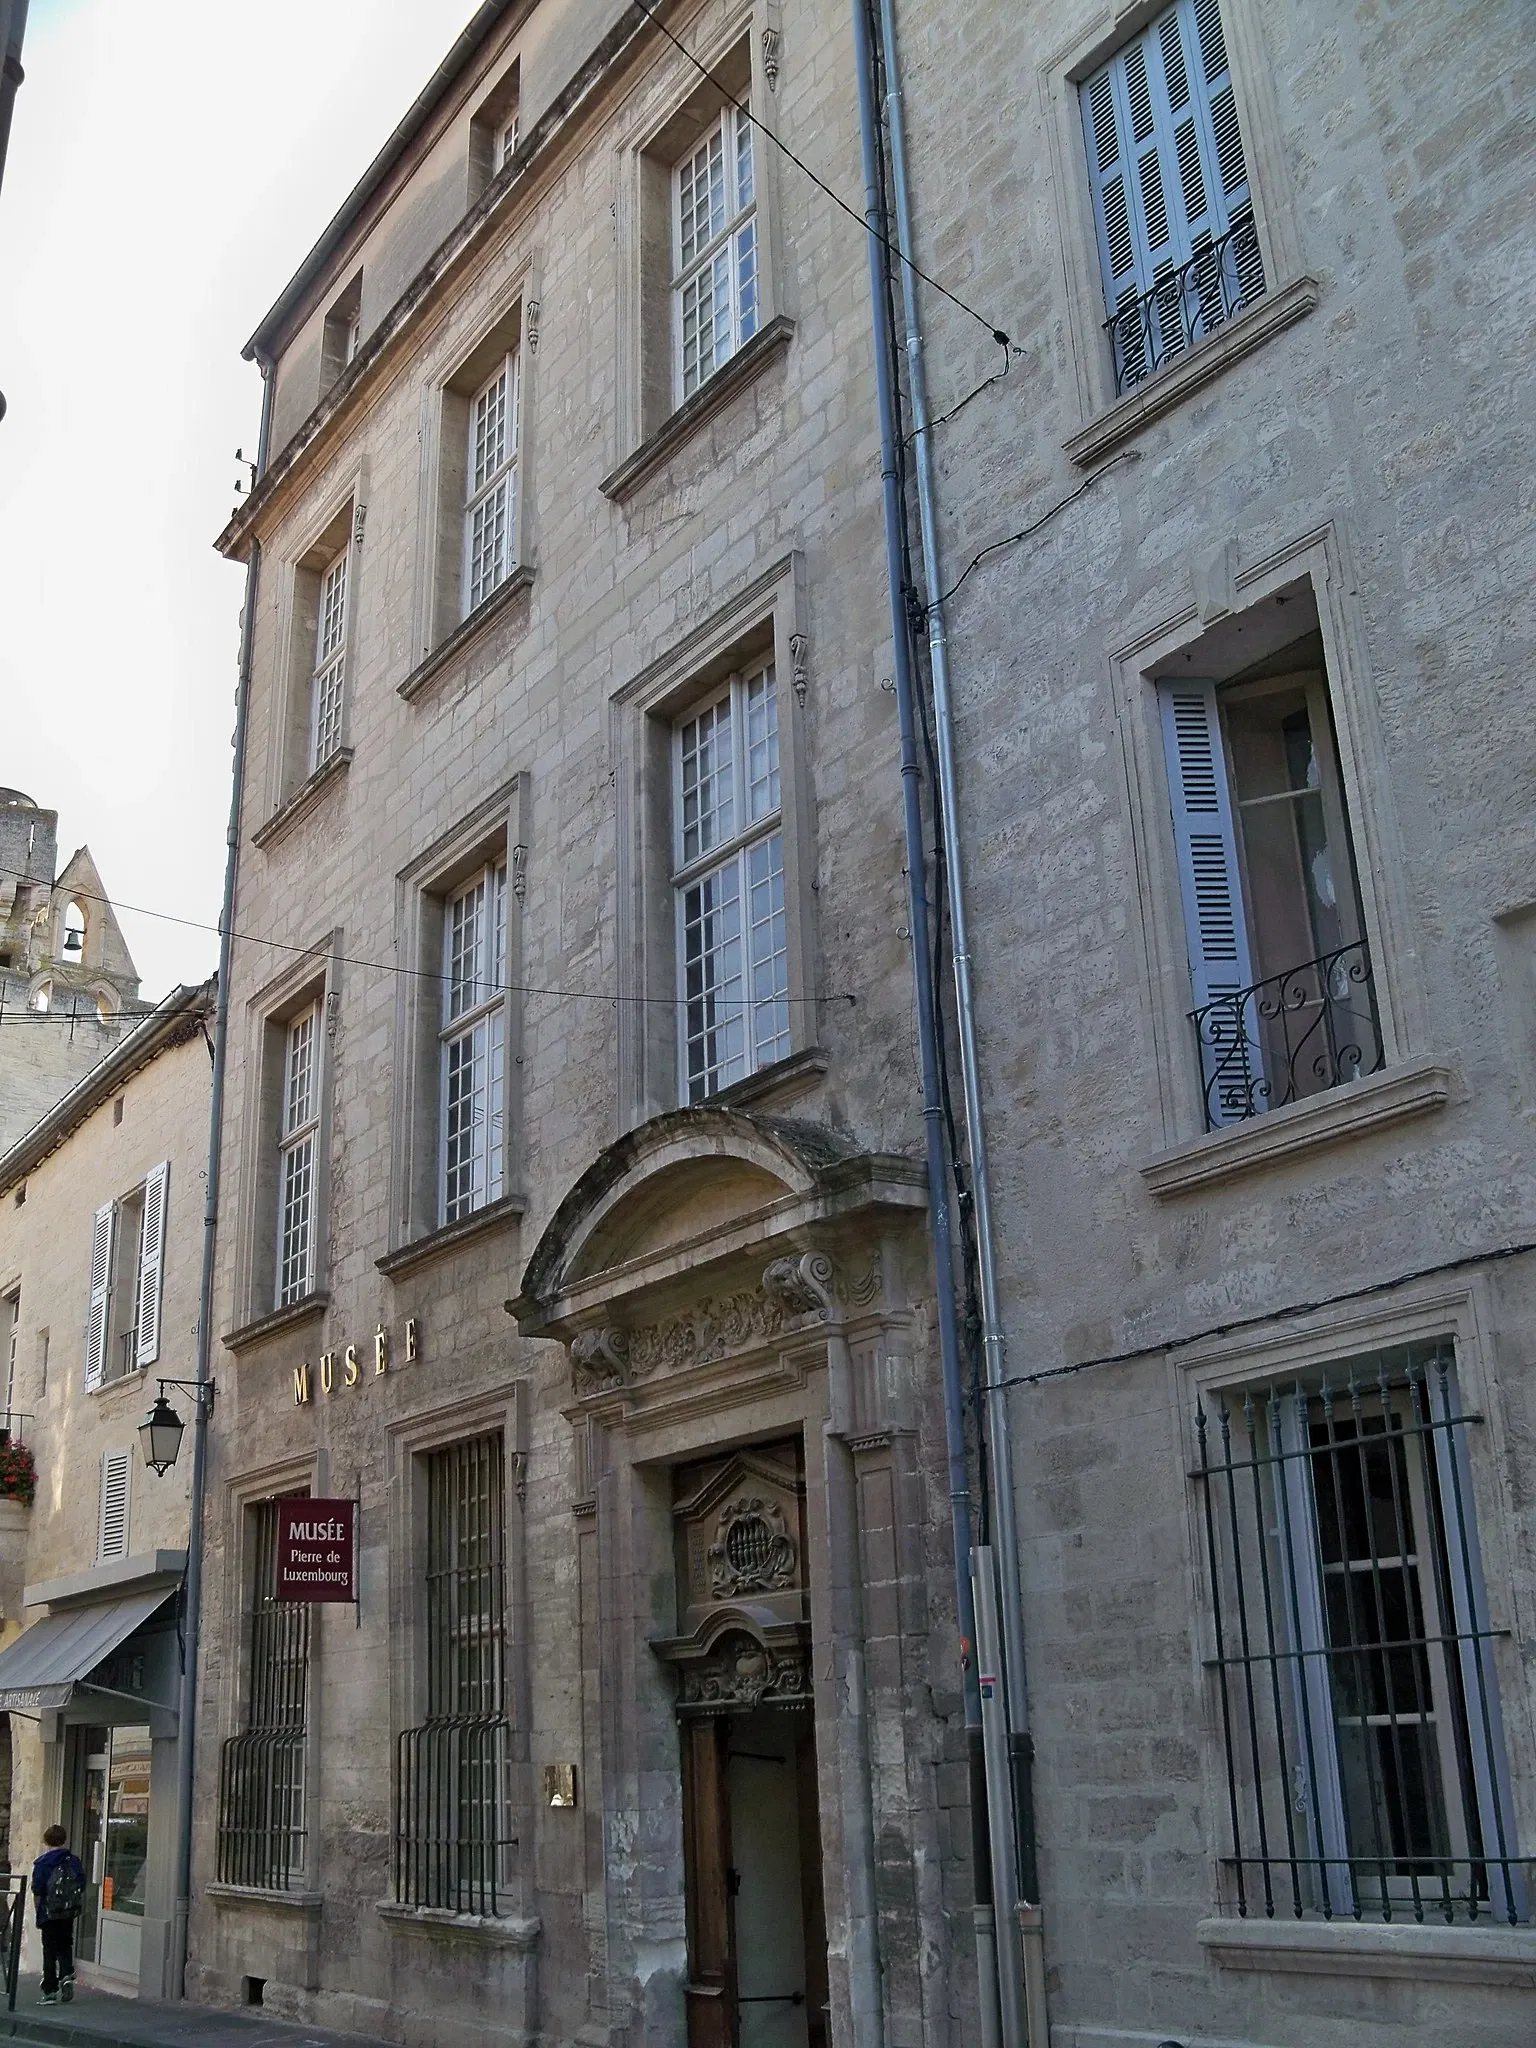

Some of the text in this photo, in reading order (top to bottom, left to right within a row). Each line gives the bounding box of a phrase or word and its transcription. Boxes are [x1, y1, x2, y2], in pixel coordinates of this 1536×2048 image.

[293, 1318, 417, 1406] MUSÉE
[289, 1517, 345, 1541] MUSÉE
[291, 1549, 341, 1563] Pierre de
[283, 1567, 349, 1586] Luxembourg
